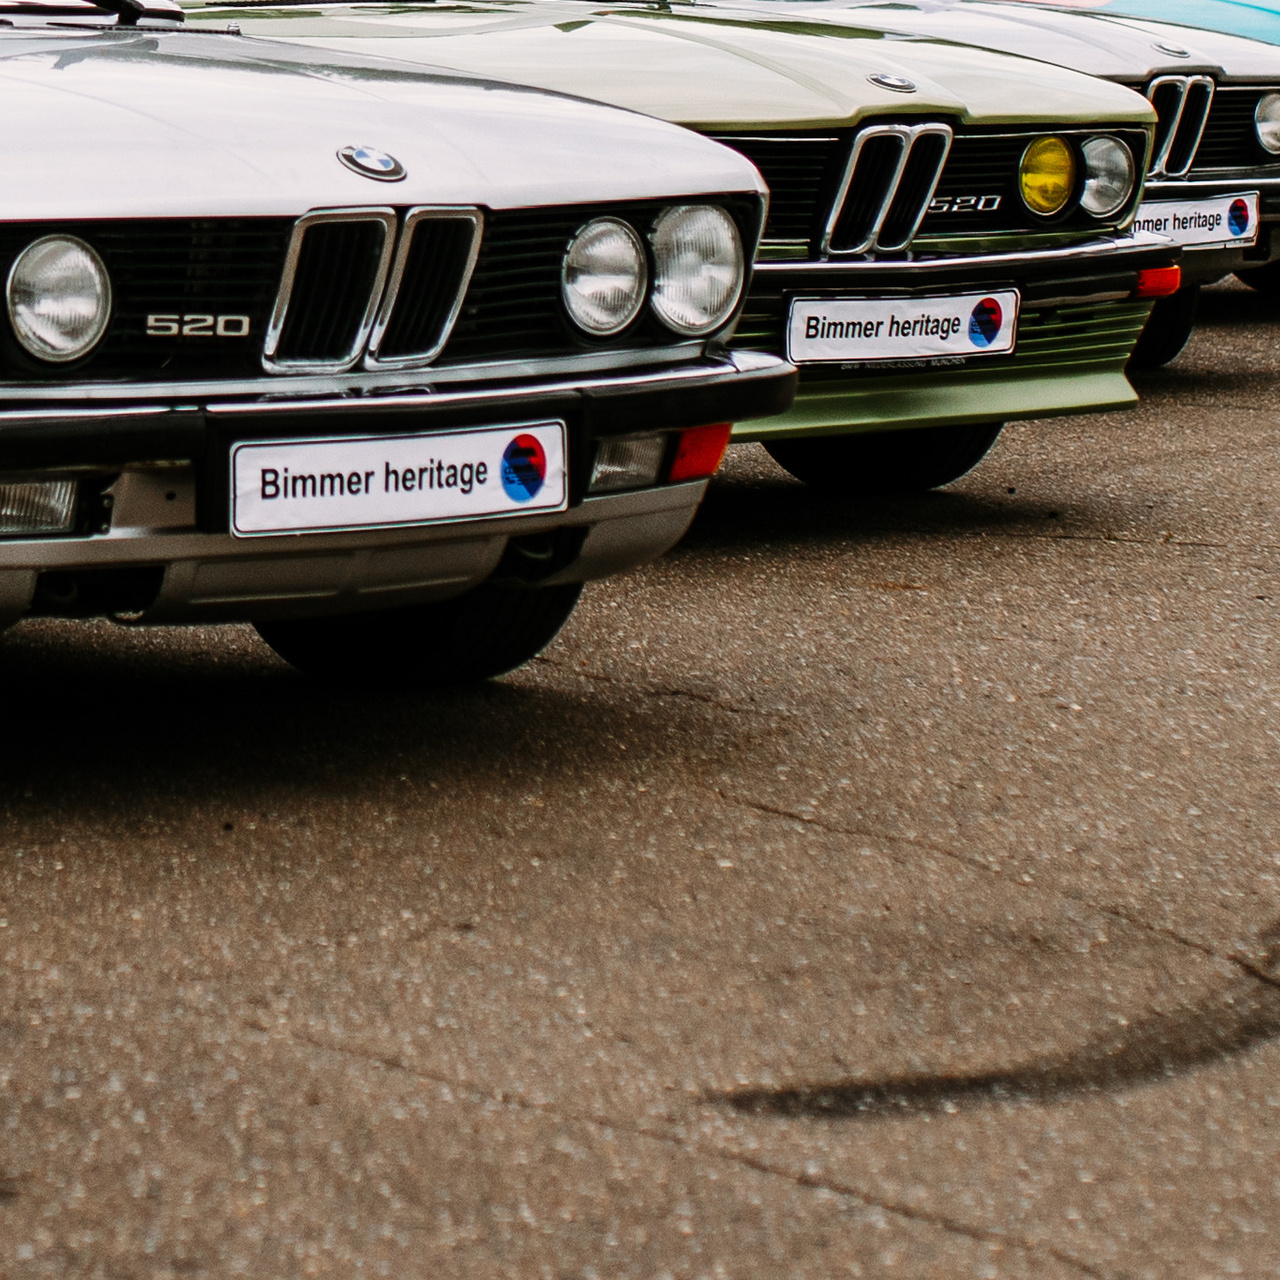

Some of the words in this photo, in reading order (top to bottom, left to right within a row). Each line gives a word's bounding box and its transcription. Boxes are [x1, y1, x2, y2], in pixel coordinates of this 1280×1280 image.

[927, 195, 1002, 214] 520
[1173, 212, 1222, 231] heritage
[146, 315, 250, 336] 520
[805, 316, 884, 339] Bimmer
[888, 314, 961, 340] heritage
[261, 467, 375, 500] Bimmer
[384, 458, 488, 494] heritage
